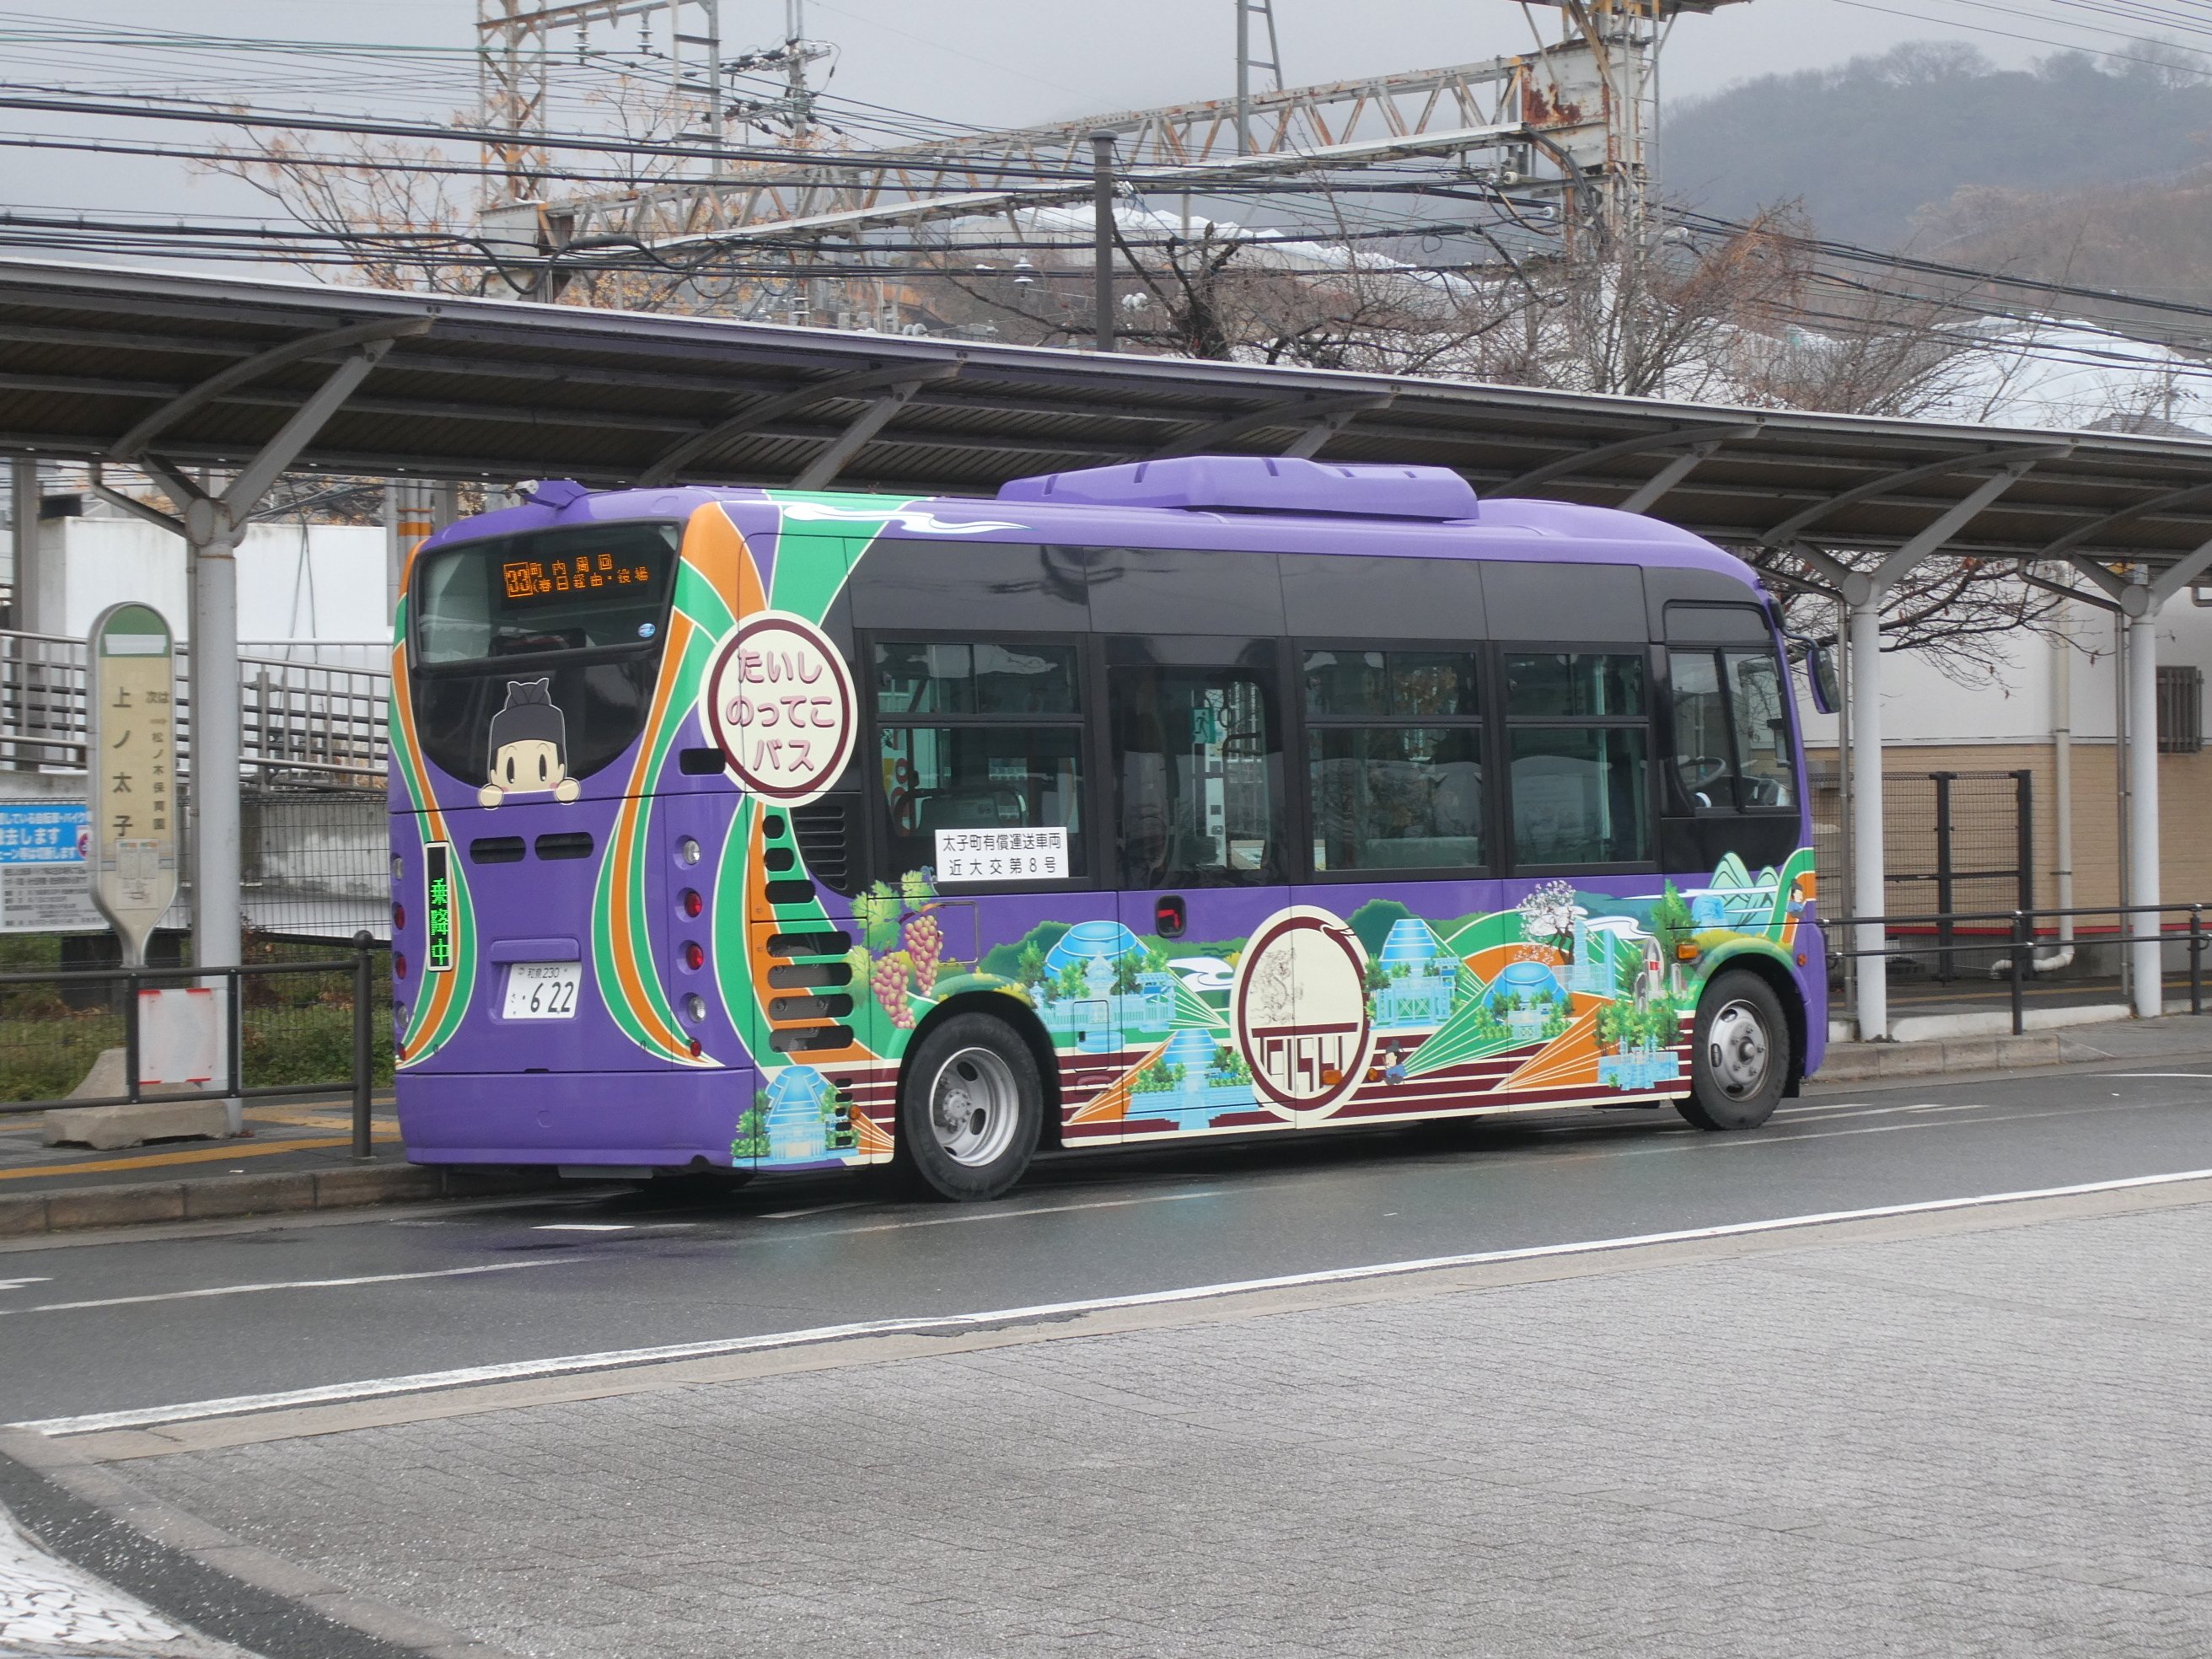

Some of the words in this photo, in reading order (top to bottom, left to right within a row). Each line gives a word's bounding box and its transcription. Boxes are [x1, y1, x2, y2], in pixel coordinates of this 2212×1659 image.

[529, 553, 613, 577] 町内周回
[738, 648, 823, 685] たいし
[146, 690, 169, 704] 次は
[726, 695, 835, 728] のってこ
[112, 686, 133, 837] 上ノ太子
[753, 739, 815, 772] バス
[152, 732, 165, 830] 松ノ木保育園
[942, 833, 1061, 851] 太子町有償運送車両
[949, 856, 1056, 876] 近大交第8号
